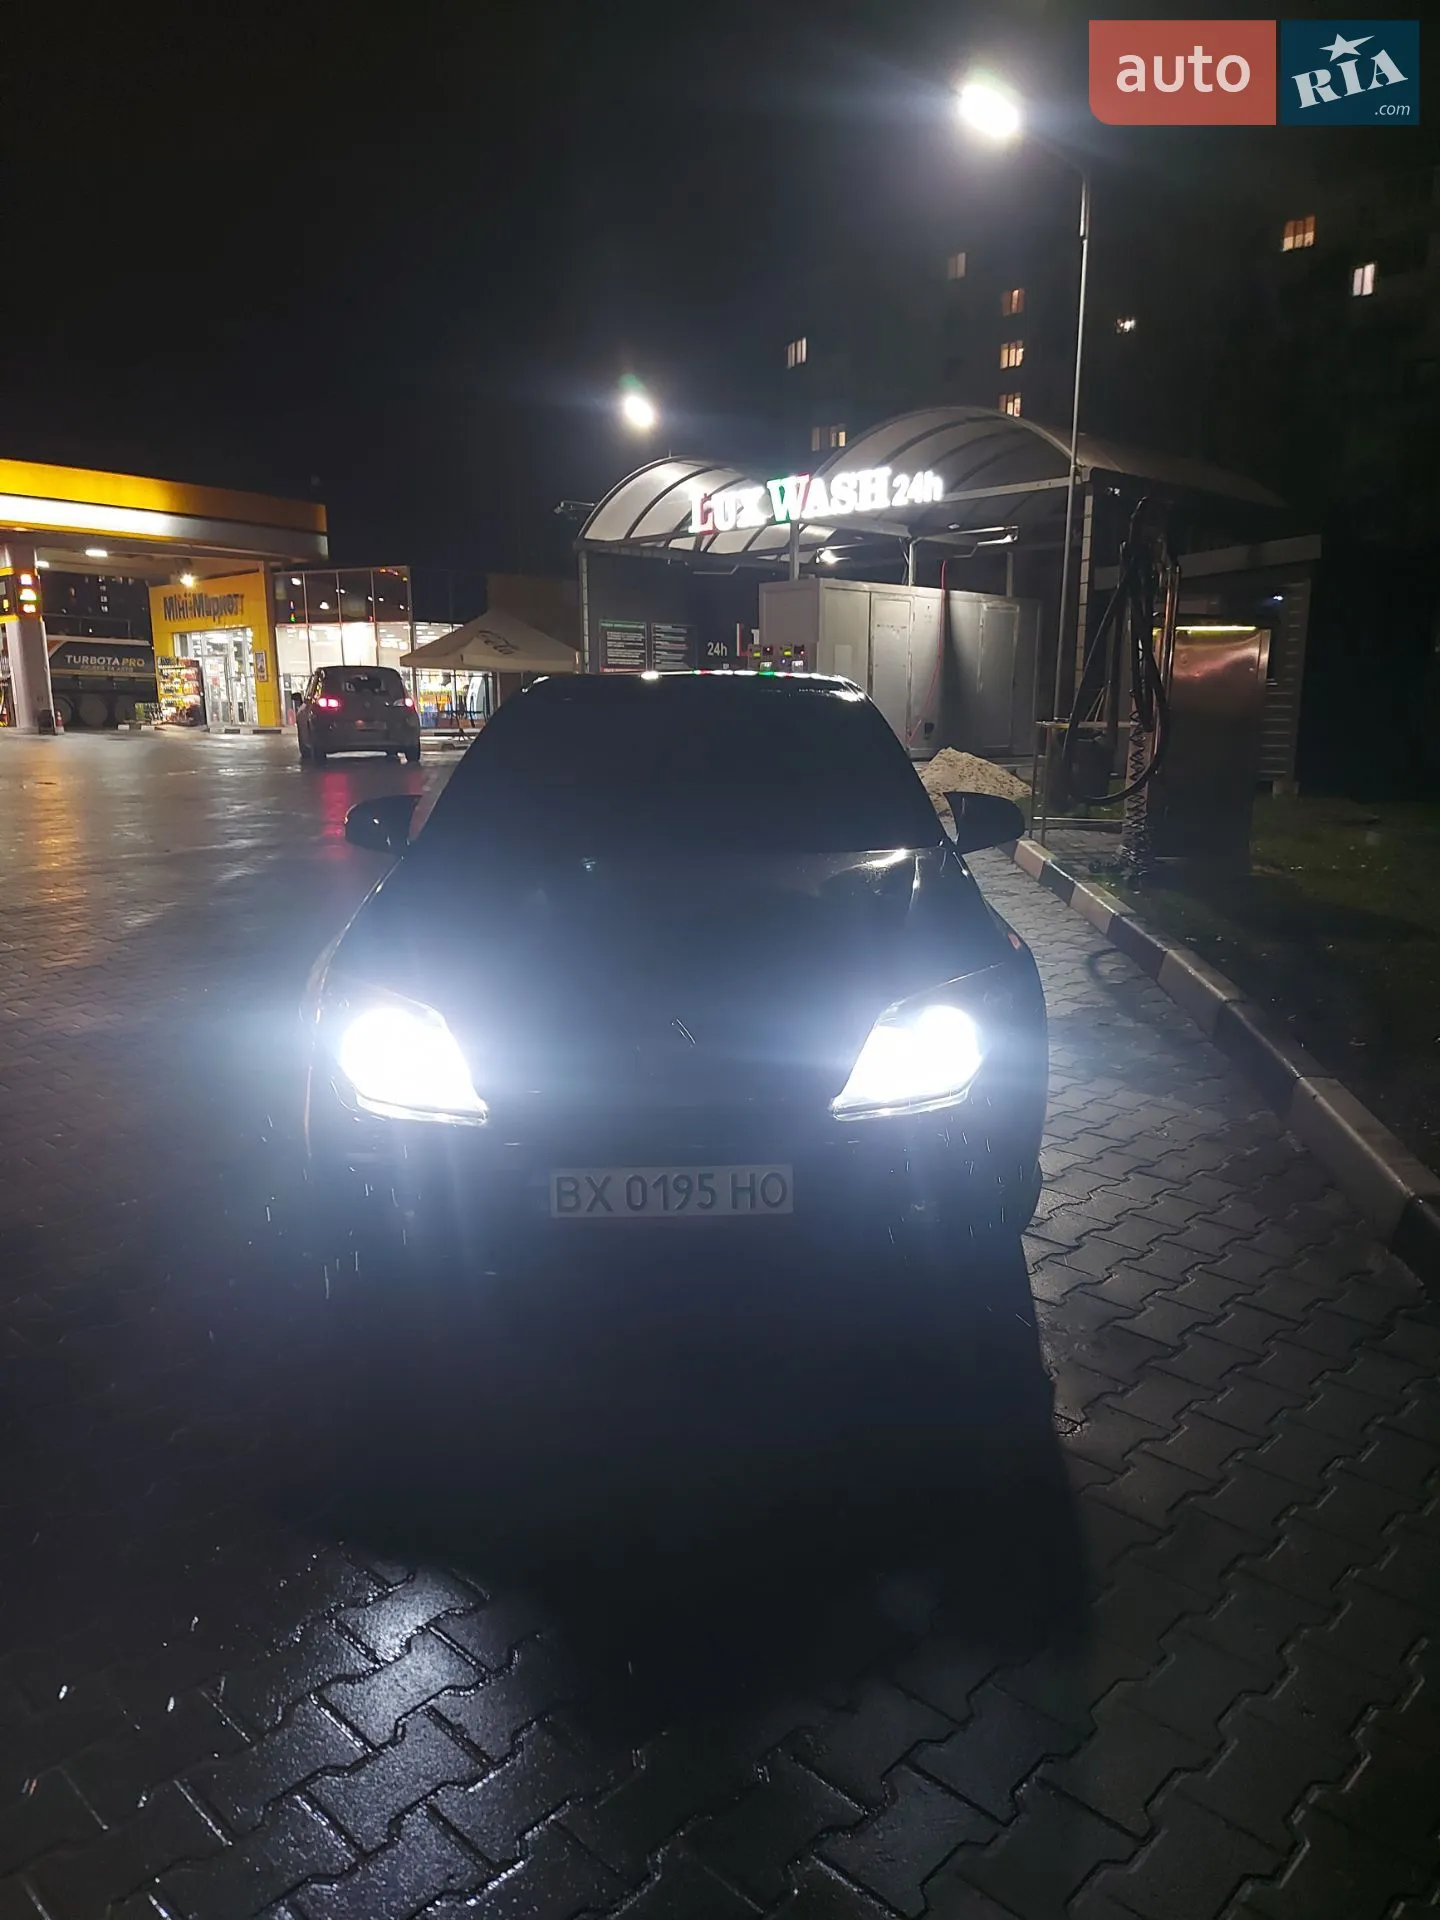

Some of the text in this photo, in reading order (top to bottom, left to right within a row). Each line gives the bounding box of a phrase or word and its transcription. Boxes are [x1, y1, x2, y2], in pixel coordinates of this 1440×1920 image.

[767, 467, 892, 521] WASH
[892, 471, 943, 506] 24h
[65, 654, 145, 667] TURBOTA PRO
[707, 641, 728, 656] 24h
[556, 1172, 787, 1213] BX 0195 HO
